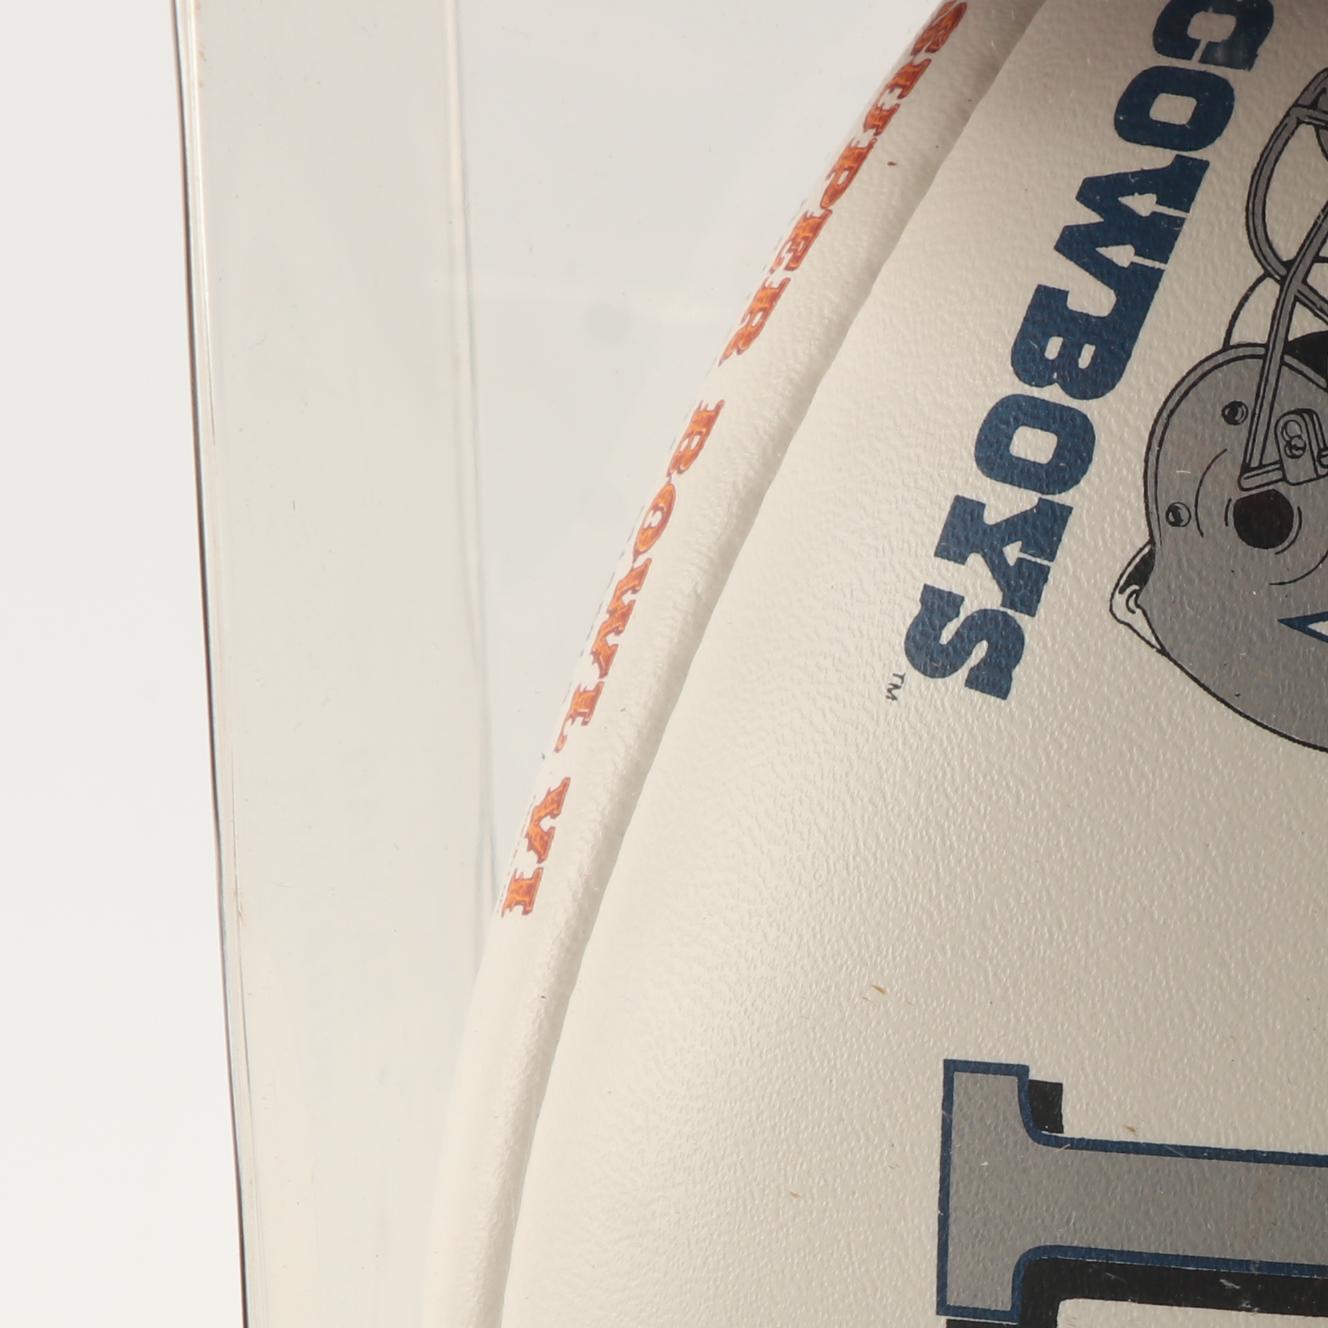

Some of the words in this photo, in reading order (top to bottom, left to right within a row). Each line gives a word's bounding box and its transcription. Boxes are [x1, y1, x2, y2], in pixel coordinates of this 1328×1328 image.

[718, 0, 968, 368] SUPER
[903, 0, 1276, 700] COWBOYS
[553, 399, 725, 753] BOWL
